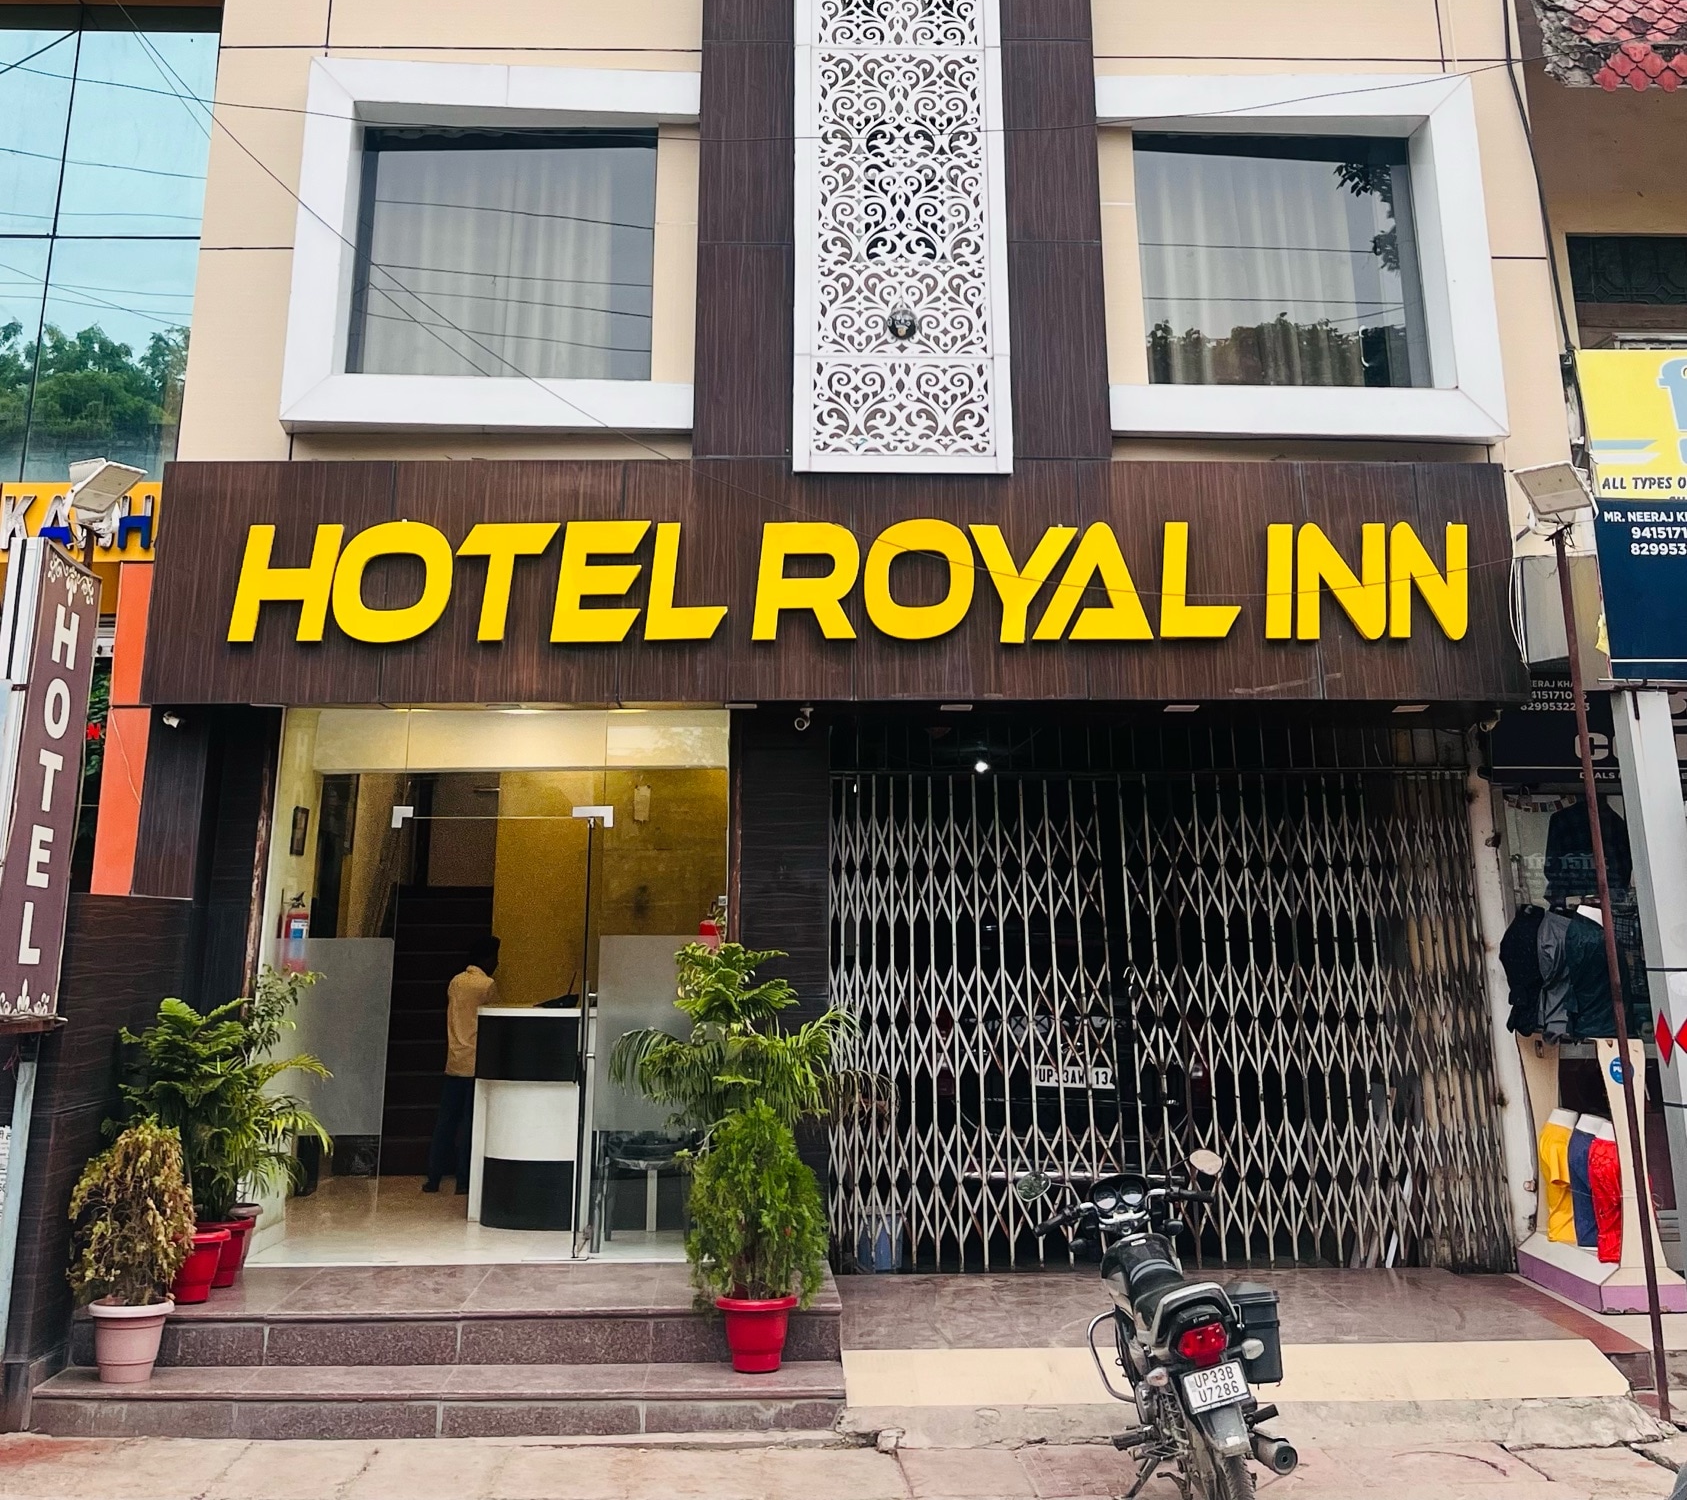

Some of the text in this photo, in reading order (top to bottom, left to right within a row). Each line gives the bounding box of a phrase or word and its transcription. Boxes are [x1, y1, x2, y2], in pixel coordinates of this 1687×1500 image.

[1602, 477, 1627, 490] ALL
[1632, 476, 1673, 490] TYPES
[1603, 510, 1626, 523] MR.
[1627, 510, 1674, 523] NEERAJ
[227, 519, 1468, 644] HOTEL ROYAL INN
[1530, 679, 1555, 688] ERAJ
[18, 603, 81, 965] HOTEL
[1194, 1366, 1234, 1389] UP33B
[1199, 1380, 1240, 1403] U7286
